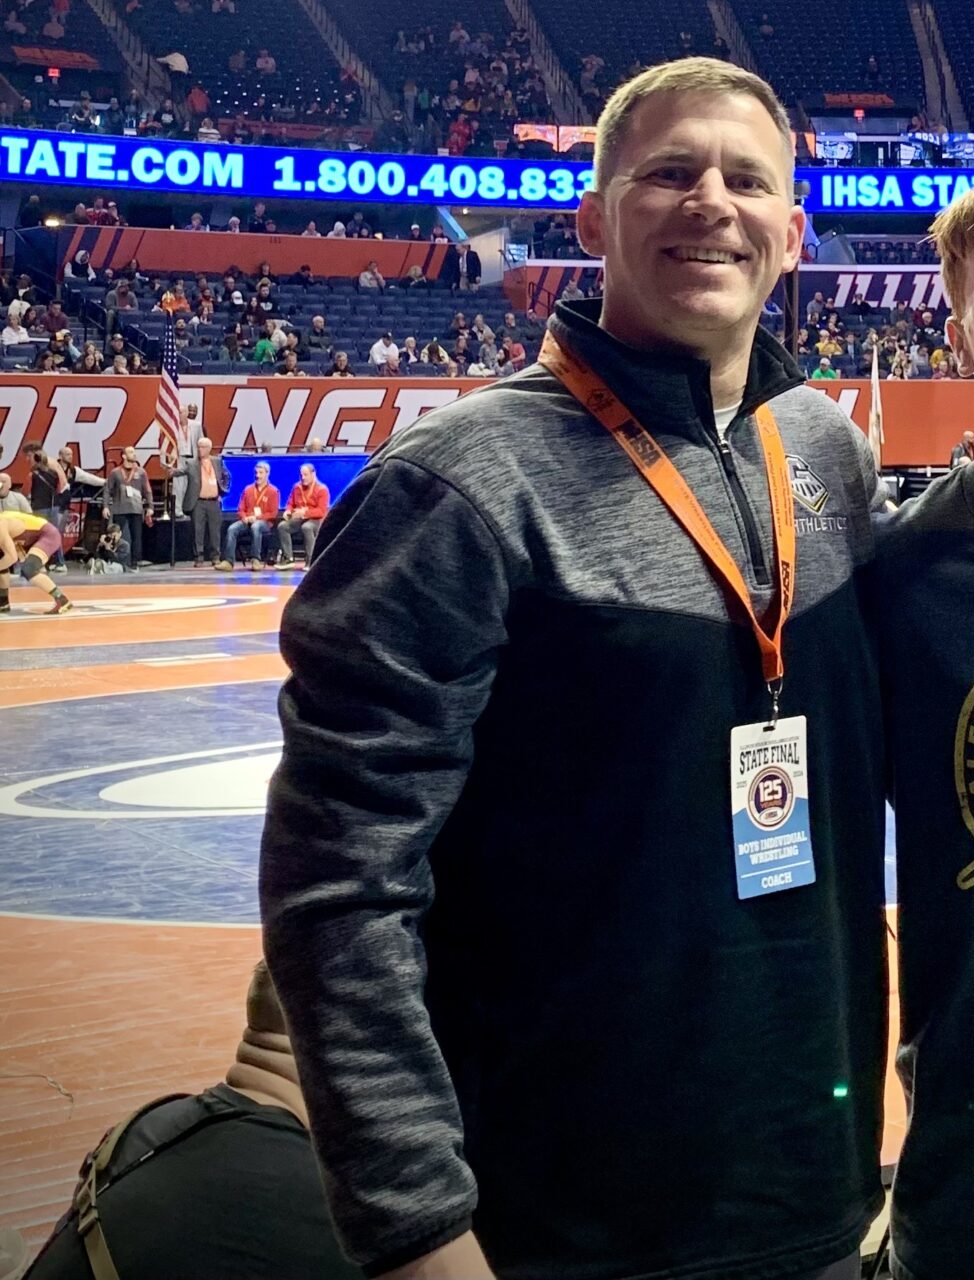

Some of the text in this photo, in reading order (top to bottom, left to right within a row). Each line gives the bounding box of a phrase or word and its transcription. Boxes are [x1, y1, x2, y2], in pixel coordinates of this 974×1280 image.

[822, 174, 903, 208] IHSA
[739, 747, 769, 775] STATE
[771, 742, 800, 766] FINAL
[759, 779, 783, 803] 125
[738, 841, 760, 857] BOYS
[750, 846, 799, 866] WRESTLING
[761, 871, 793, 889] COACH
